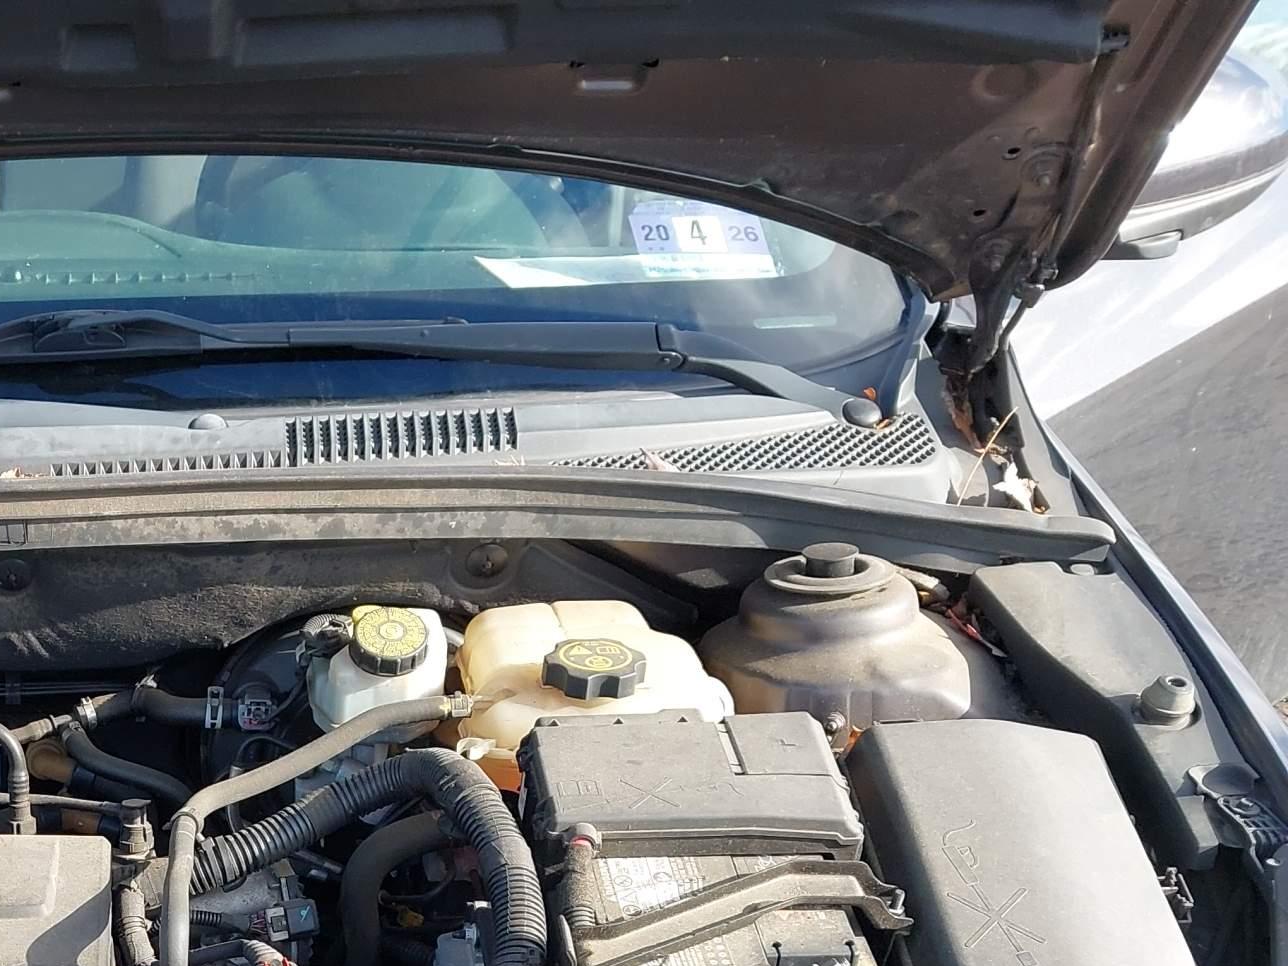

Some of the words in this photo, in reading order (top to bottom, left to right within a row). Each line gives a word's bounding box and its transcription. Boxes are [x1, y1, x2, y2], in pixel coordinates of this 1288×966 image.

[641, 224, 670, 241] 20
[690, 219, 707, 246] 4
[727, 225, 759, 242] 26
